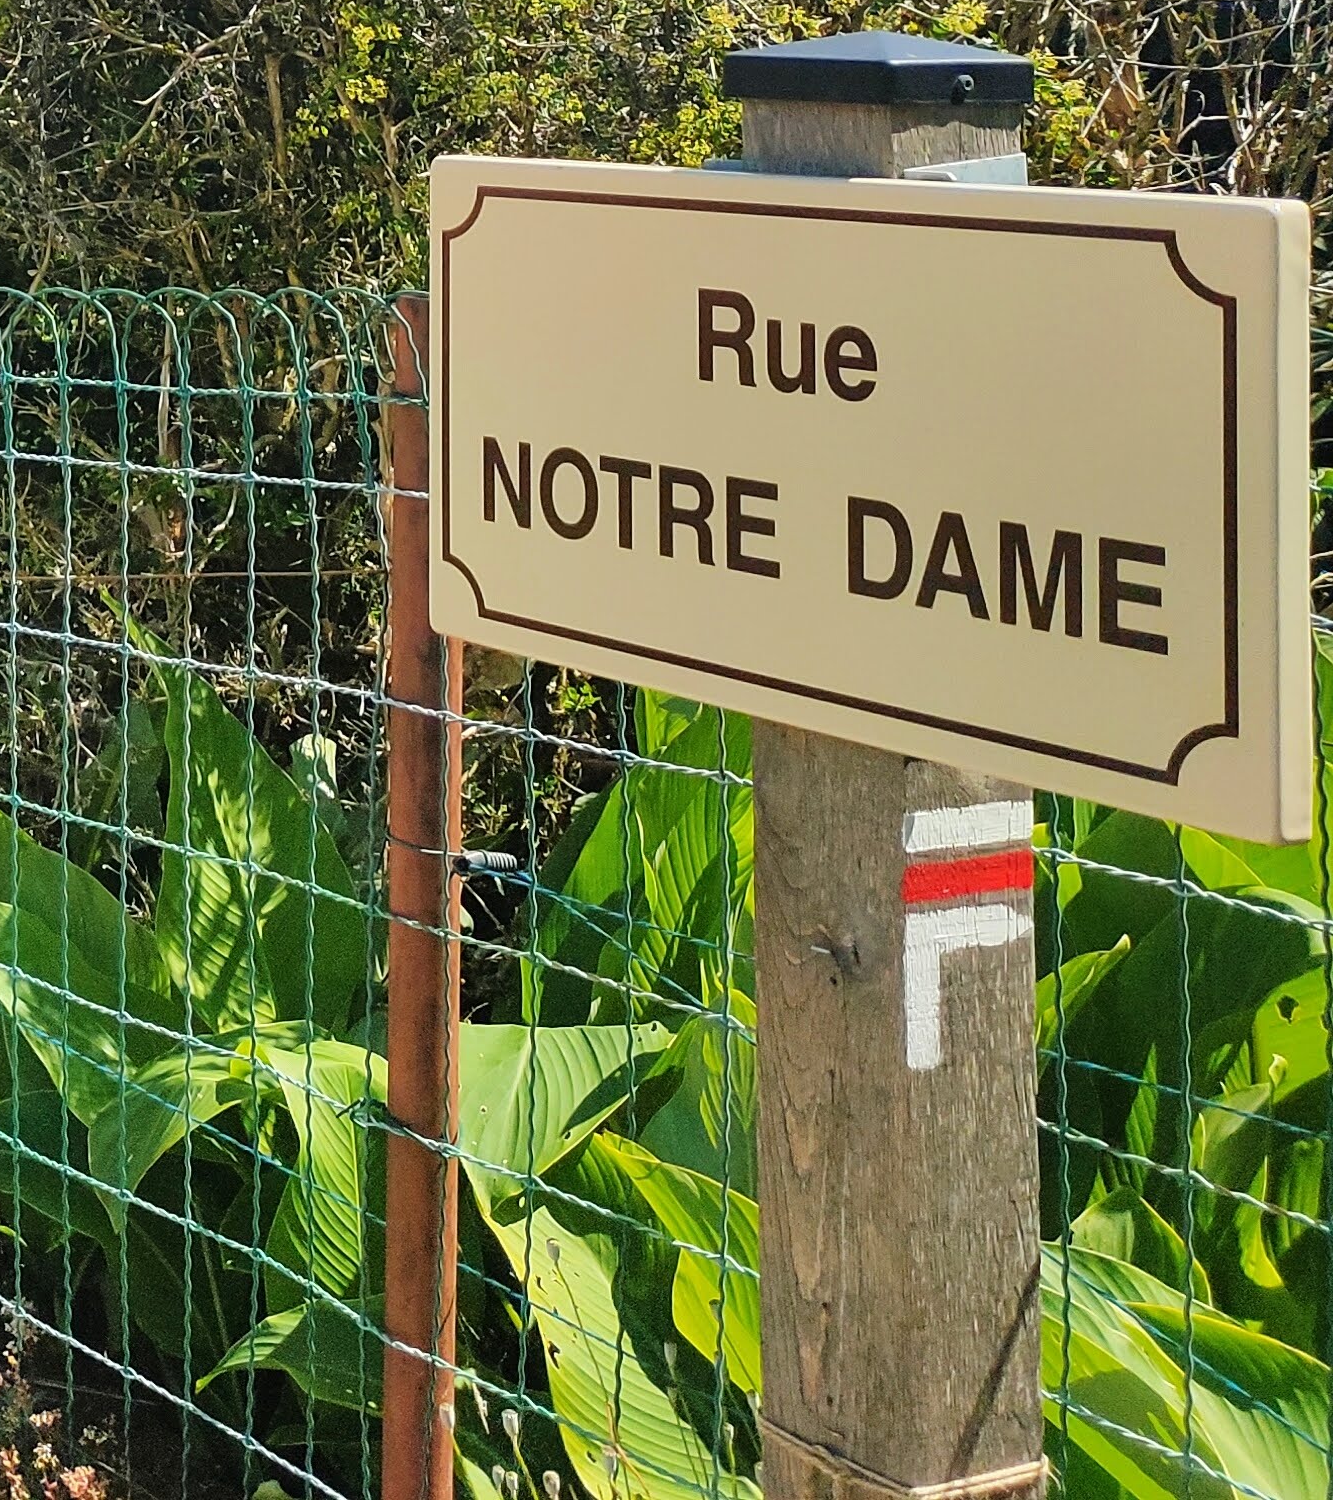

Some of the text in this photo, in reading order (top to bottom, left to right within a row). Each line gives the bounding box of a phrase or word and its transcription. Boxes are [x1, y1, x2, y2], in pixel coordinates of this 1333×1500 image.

[697, 287, 878, 402] Rue
[482, 436, 1169, 656] NOTRE DAME
